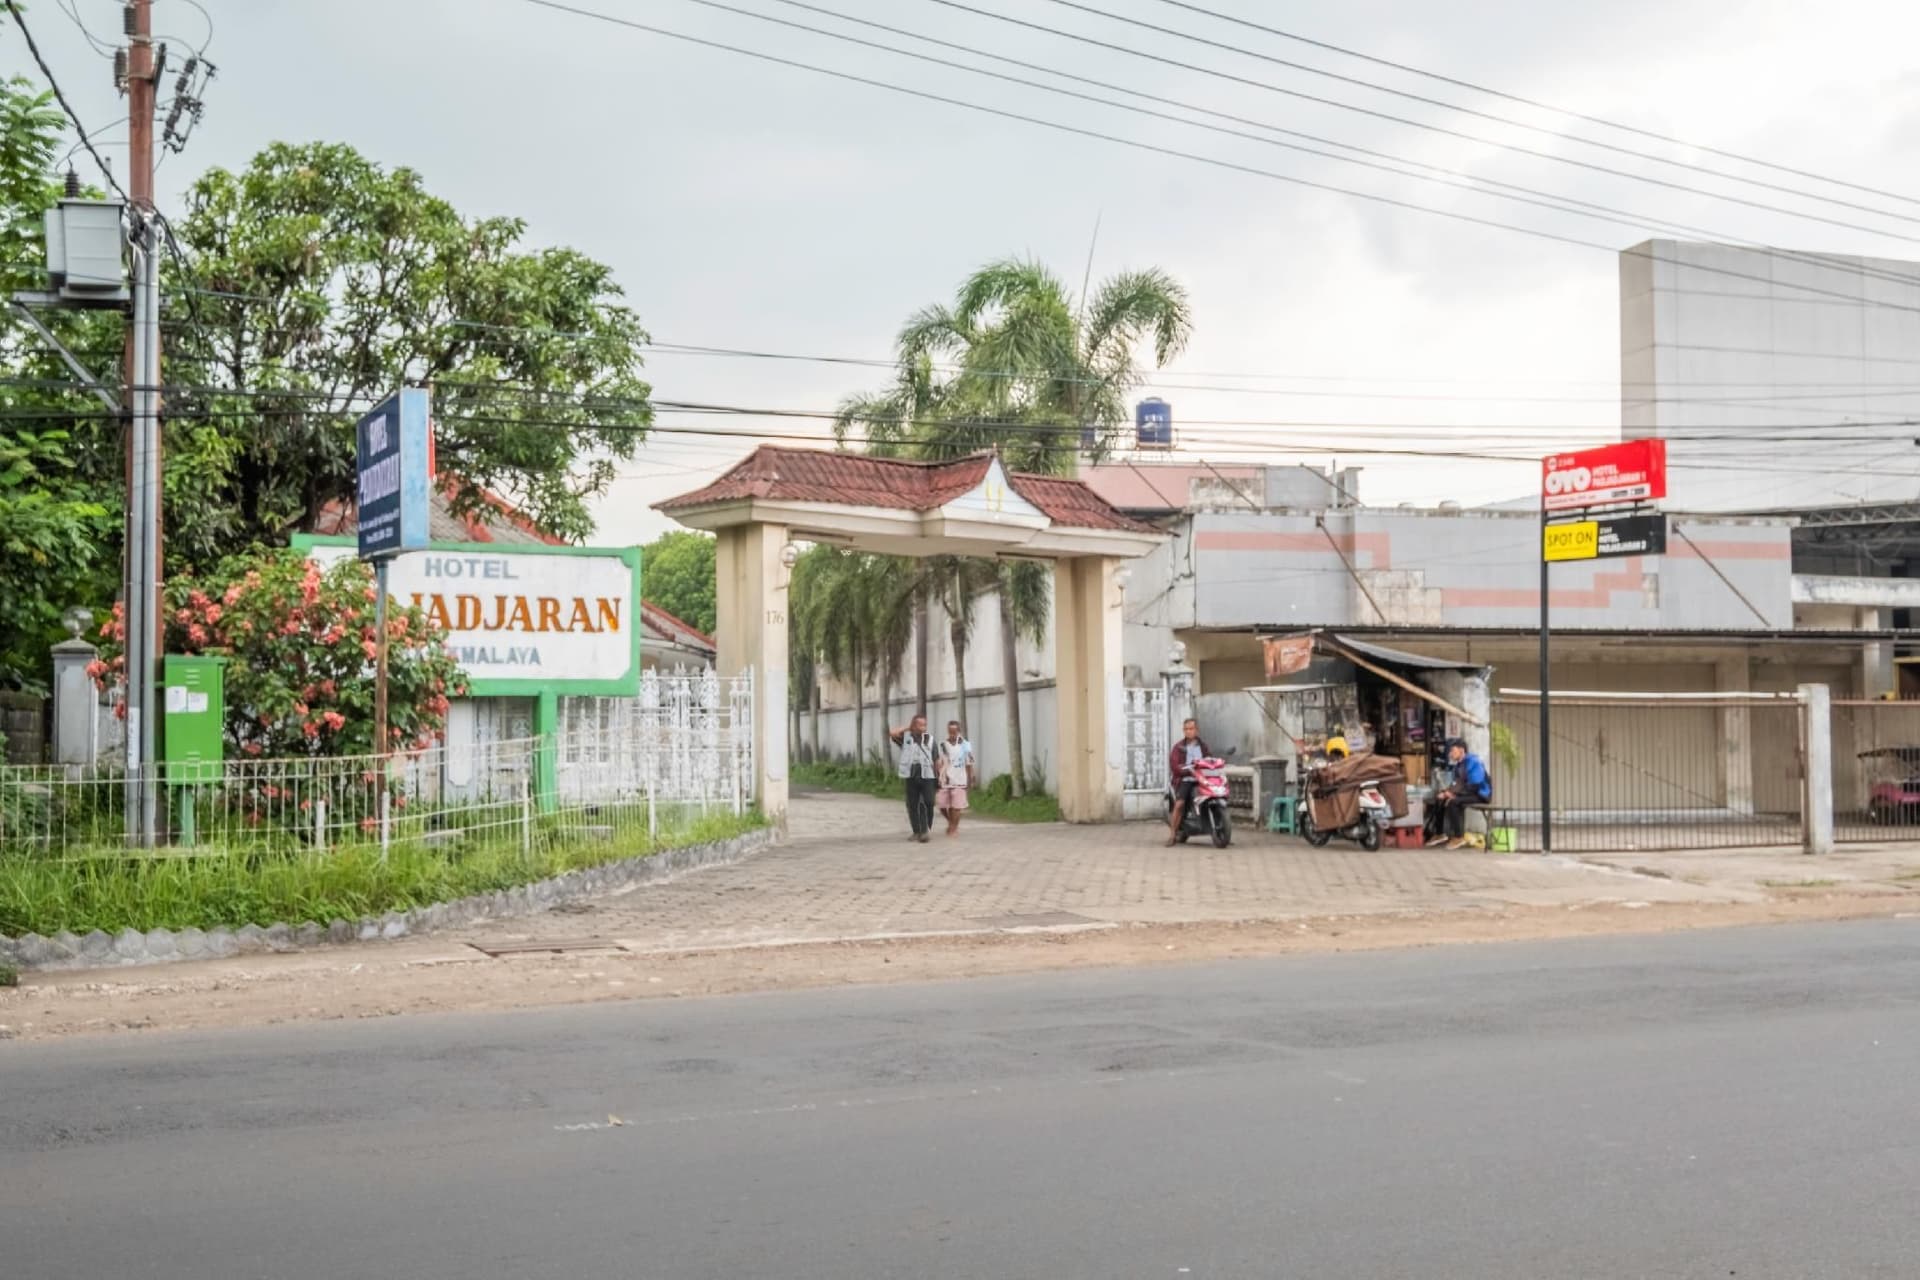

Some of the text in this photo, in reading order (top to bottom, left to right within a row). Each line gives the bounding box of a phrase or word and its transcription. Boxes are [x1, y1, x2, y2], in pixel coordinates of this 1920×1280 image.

[1544, 466, 1592, 495] OYO
[1546, 532, 1573, 547] SPOT
[1575, 531, 1593, 545] ON
[424, 557, 519, 579] HOTEL
[765, 610, 784, 625] 176
